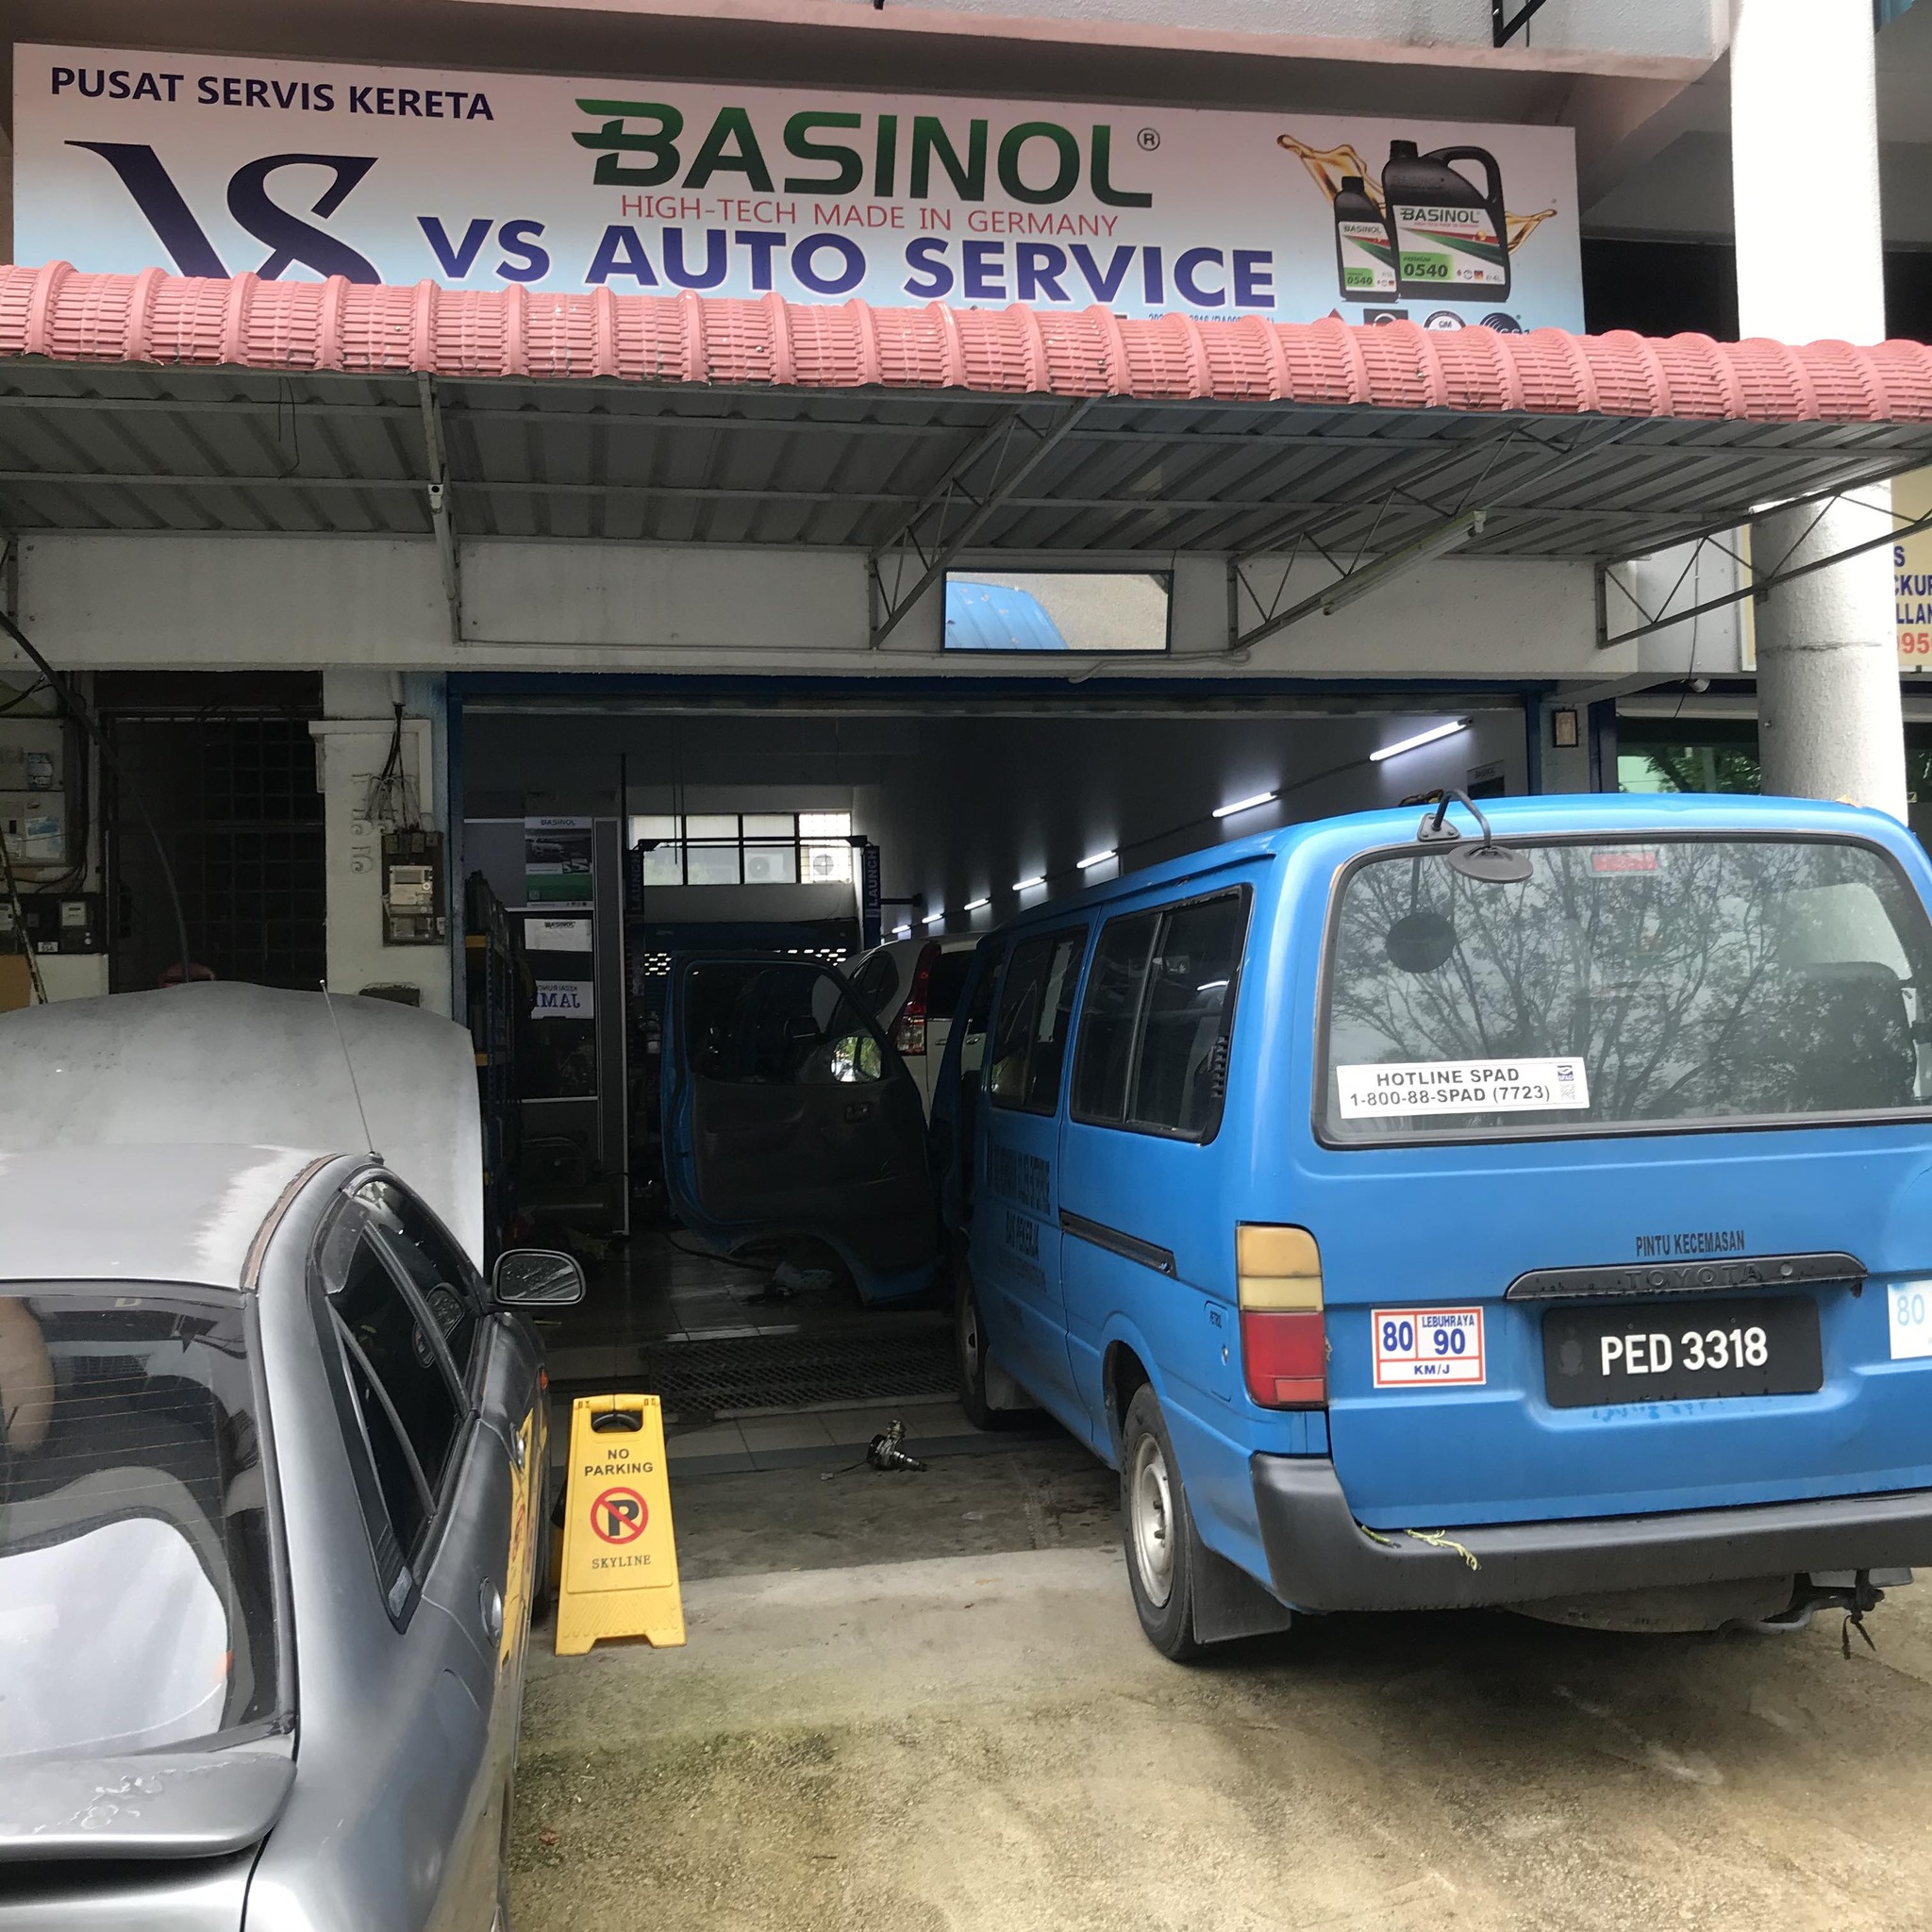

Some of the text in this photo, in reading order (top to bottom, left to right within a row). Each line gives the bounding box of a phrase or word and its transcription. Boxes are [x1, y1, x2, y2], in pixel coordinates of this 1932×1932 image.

[51, 67, 495, 121] PUSAT SERVIS KERETA
[571, 97, 1153, 208] BASINOL
[621, 194, 1119, 237] HIGH-TECH MADE IN GERMANY
[1400, 208, 1480, 224] BASINOL
[417, 215, 1276, 308] VS AUTO SERVICE
[1404, 263, 1448, 277] 0540
[868, 849, 879, 908] LAUNCH
[1376, 1068, 1520, 1087] HOTLINE SPAD
[1350, 1085, 1550, 1107] 1-800-88-SPAD (7723)
[1636, 1230, 1745, 1257] PINTU KECEMASAN
[1624, 1263, 1763, 1290] TOYOTA
[1422, 1315, 1474, 1327] LEBUHRAYA
[1897, 1293, 1925, 1326] 80
[1383, 1321, 1413, 1352] 80
[1434, 1328, 1466, 1356] 90
[1601, 1326, 1768, 1375] PED 3318
[1414, 1364, 1450, 1374] KM/J
[608, 1449, 629, 1460] NO
[584, 1462, 654, 1476] PARKING
[591, 1555, 652, 1569] SKYLINE
